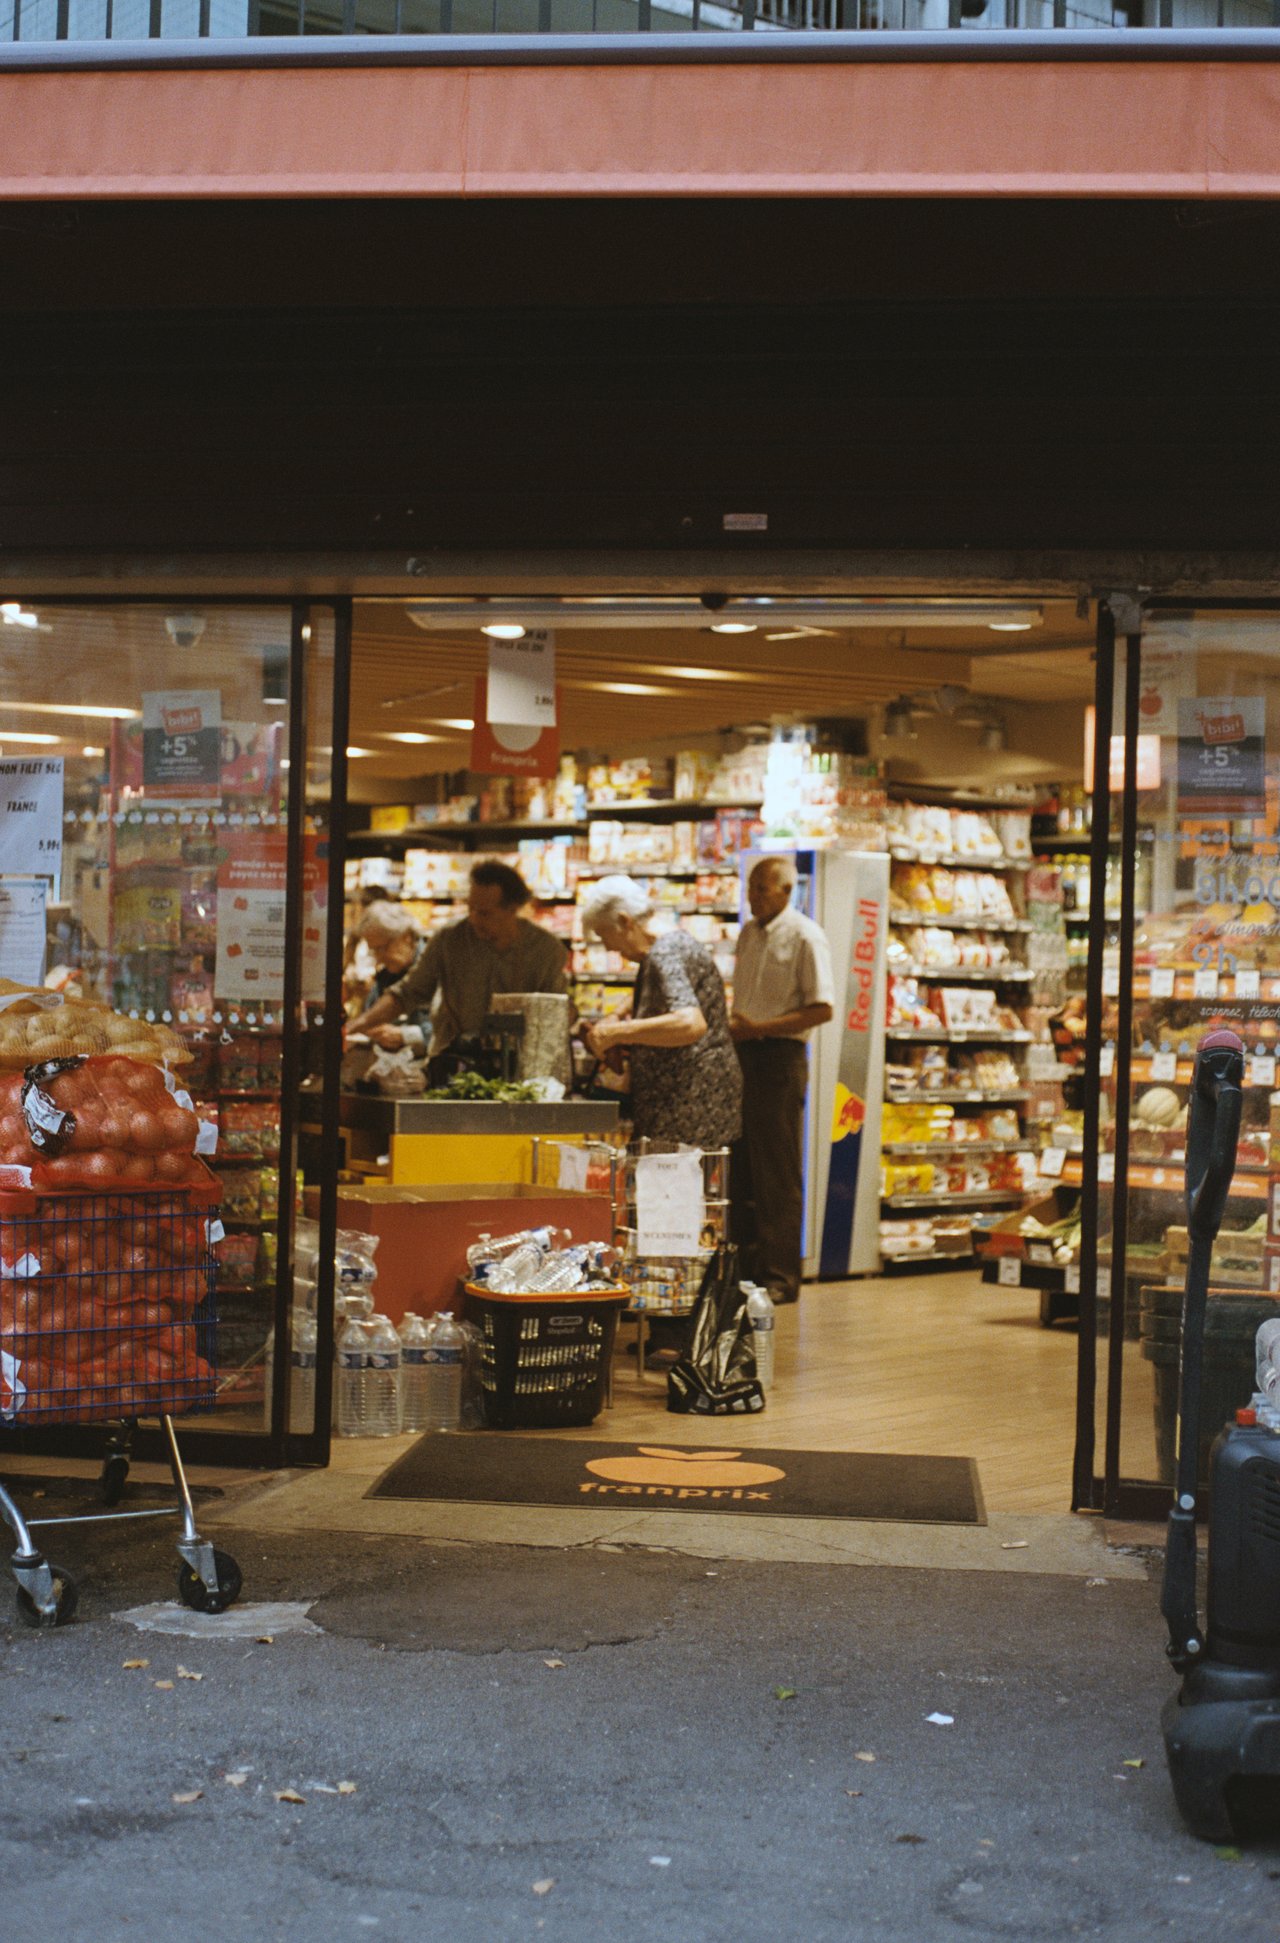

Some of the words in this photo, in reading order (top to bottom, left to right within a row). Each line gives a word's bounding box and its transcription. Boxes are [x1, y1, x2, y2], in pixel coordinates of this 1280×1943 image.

[7, 801, 38, 813] FRANCE
[855, 899, 879, 962] Bull
[1192, 943, 1238, 974] 9h
[849, 967, 873, 1032] Red
[577, 1482, 773, 1501] franprix
